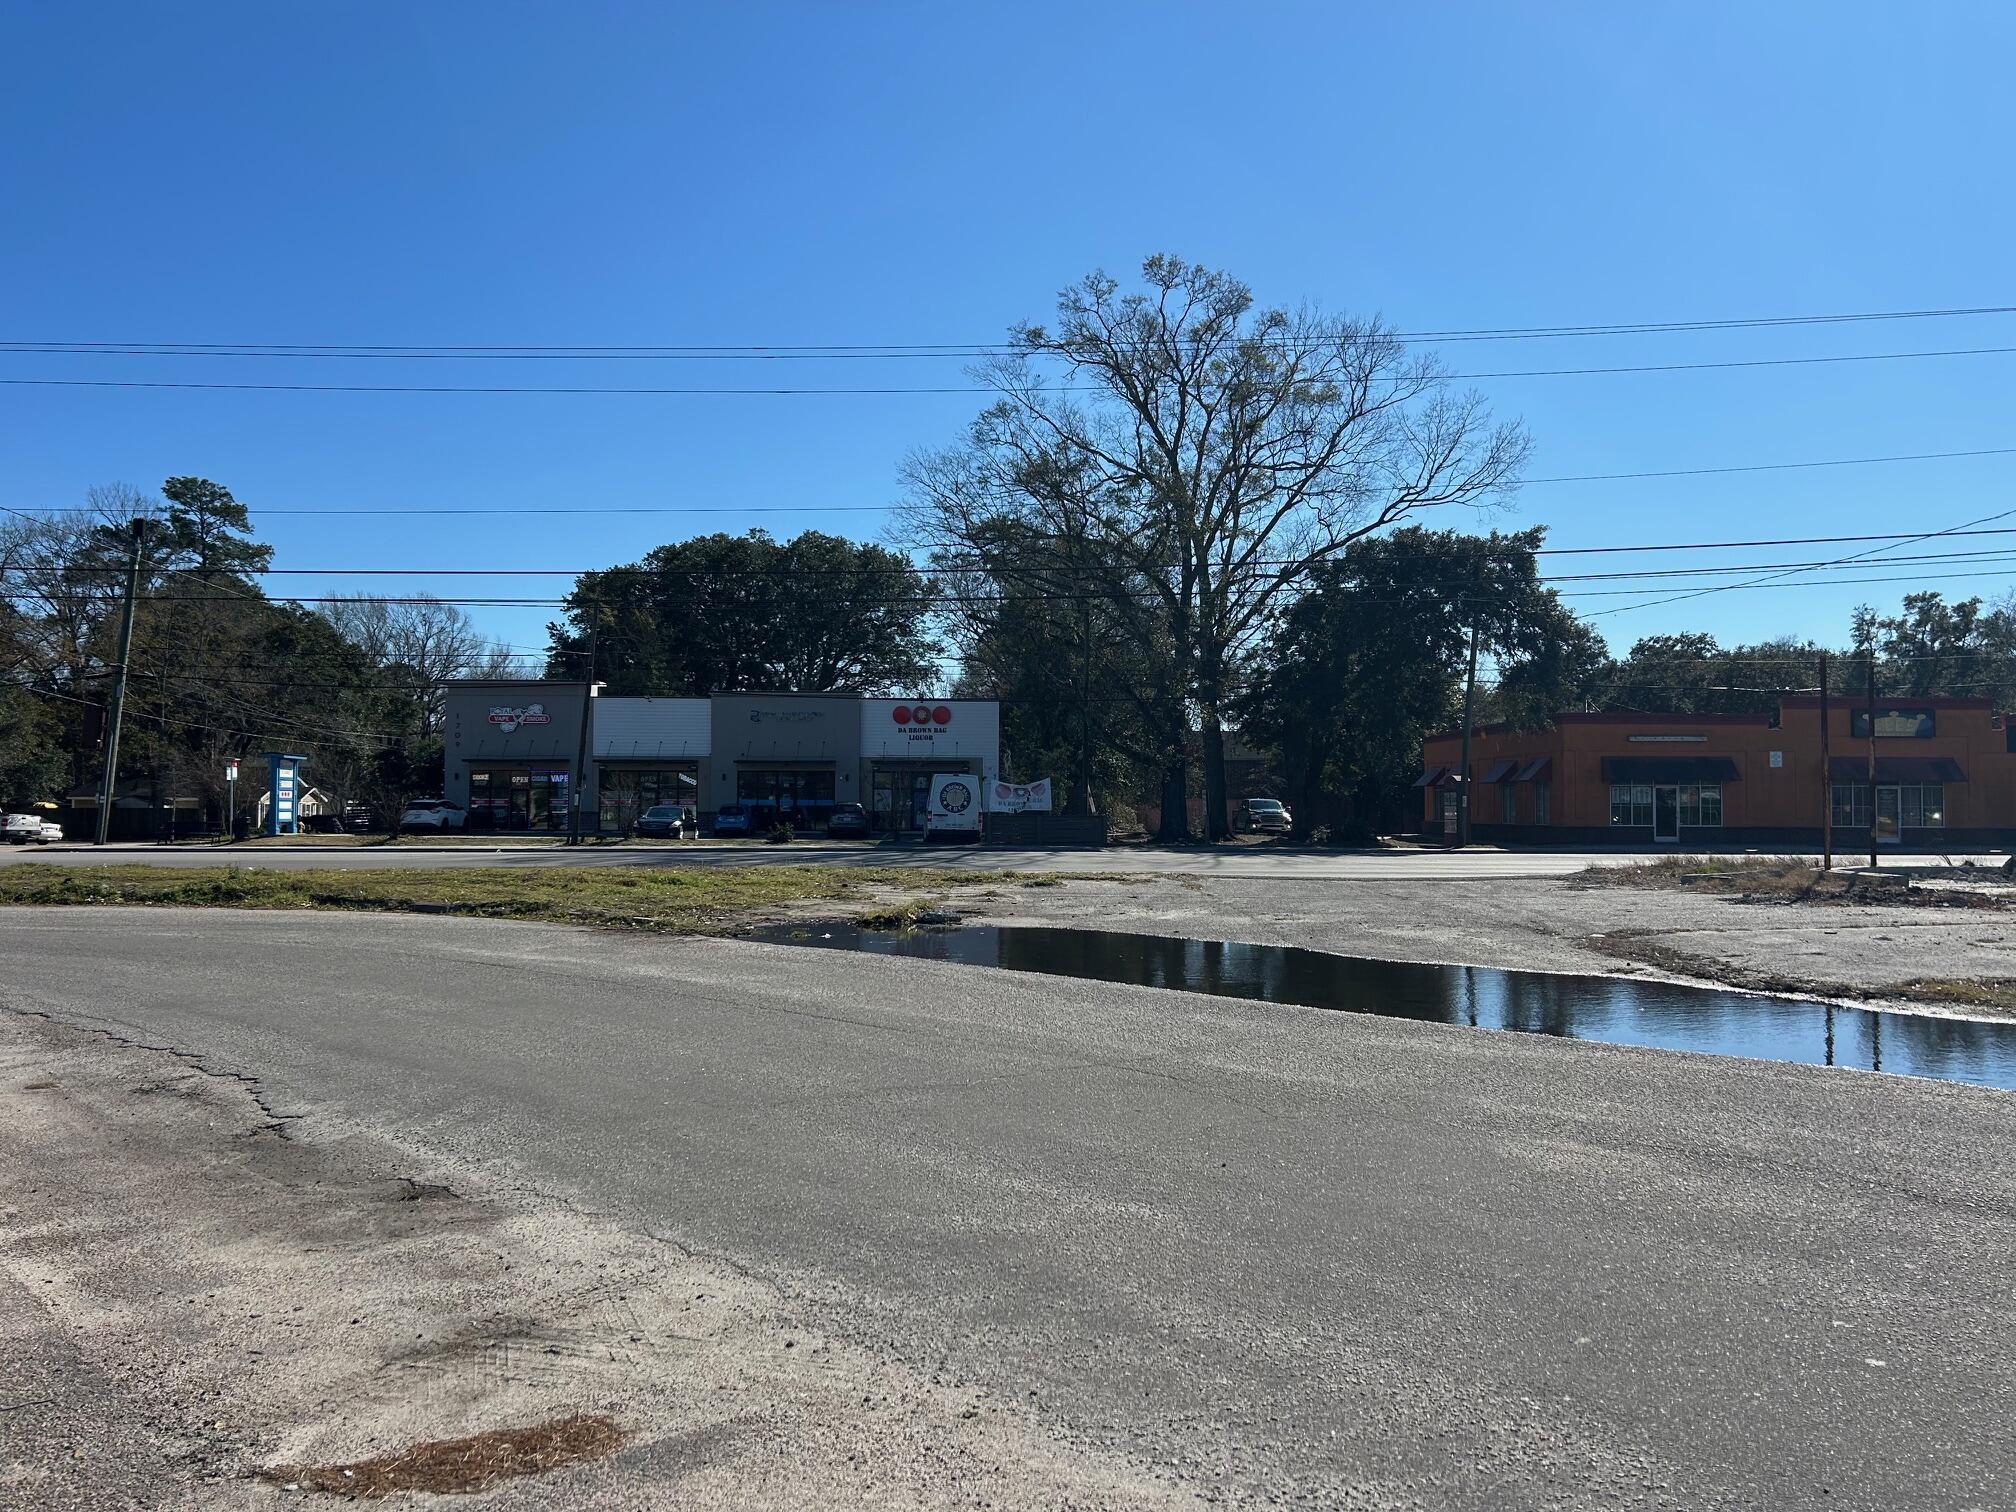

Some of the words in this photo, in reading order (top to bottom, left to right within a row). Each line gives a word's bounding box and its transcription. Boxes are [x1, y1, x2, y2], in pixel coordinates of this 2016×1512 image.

[490, 707, 513, 715] ROYAL
[550, 774, 568, 783] VAPE
[678, 772, 697, 786] TOBACCO
